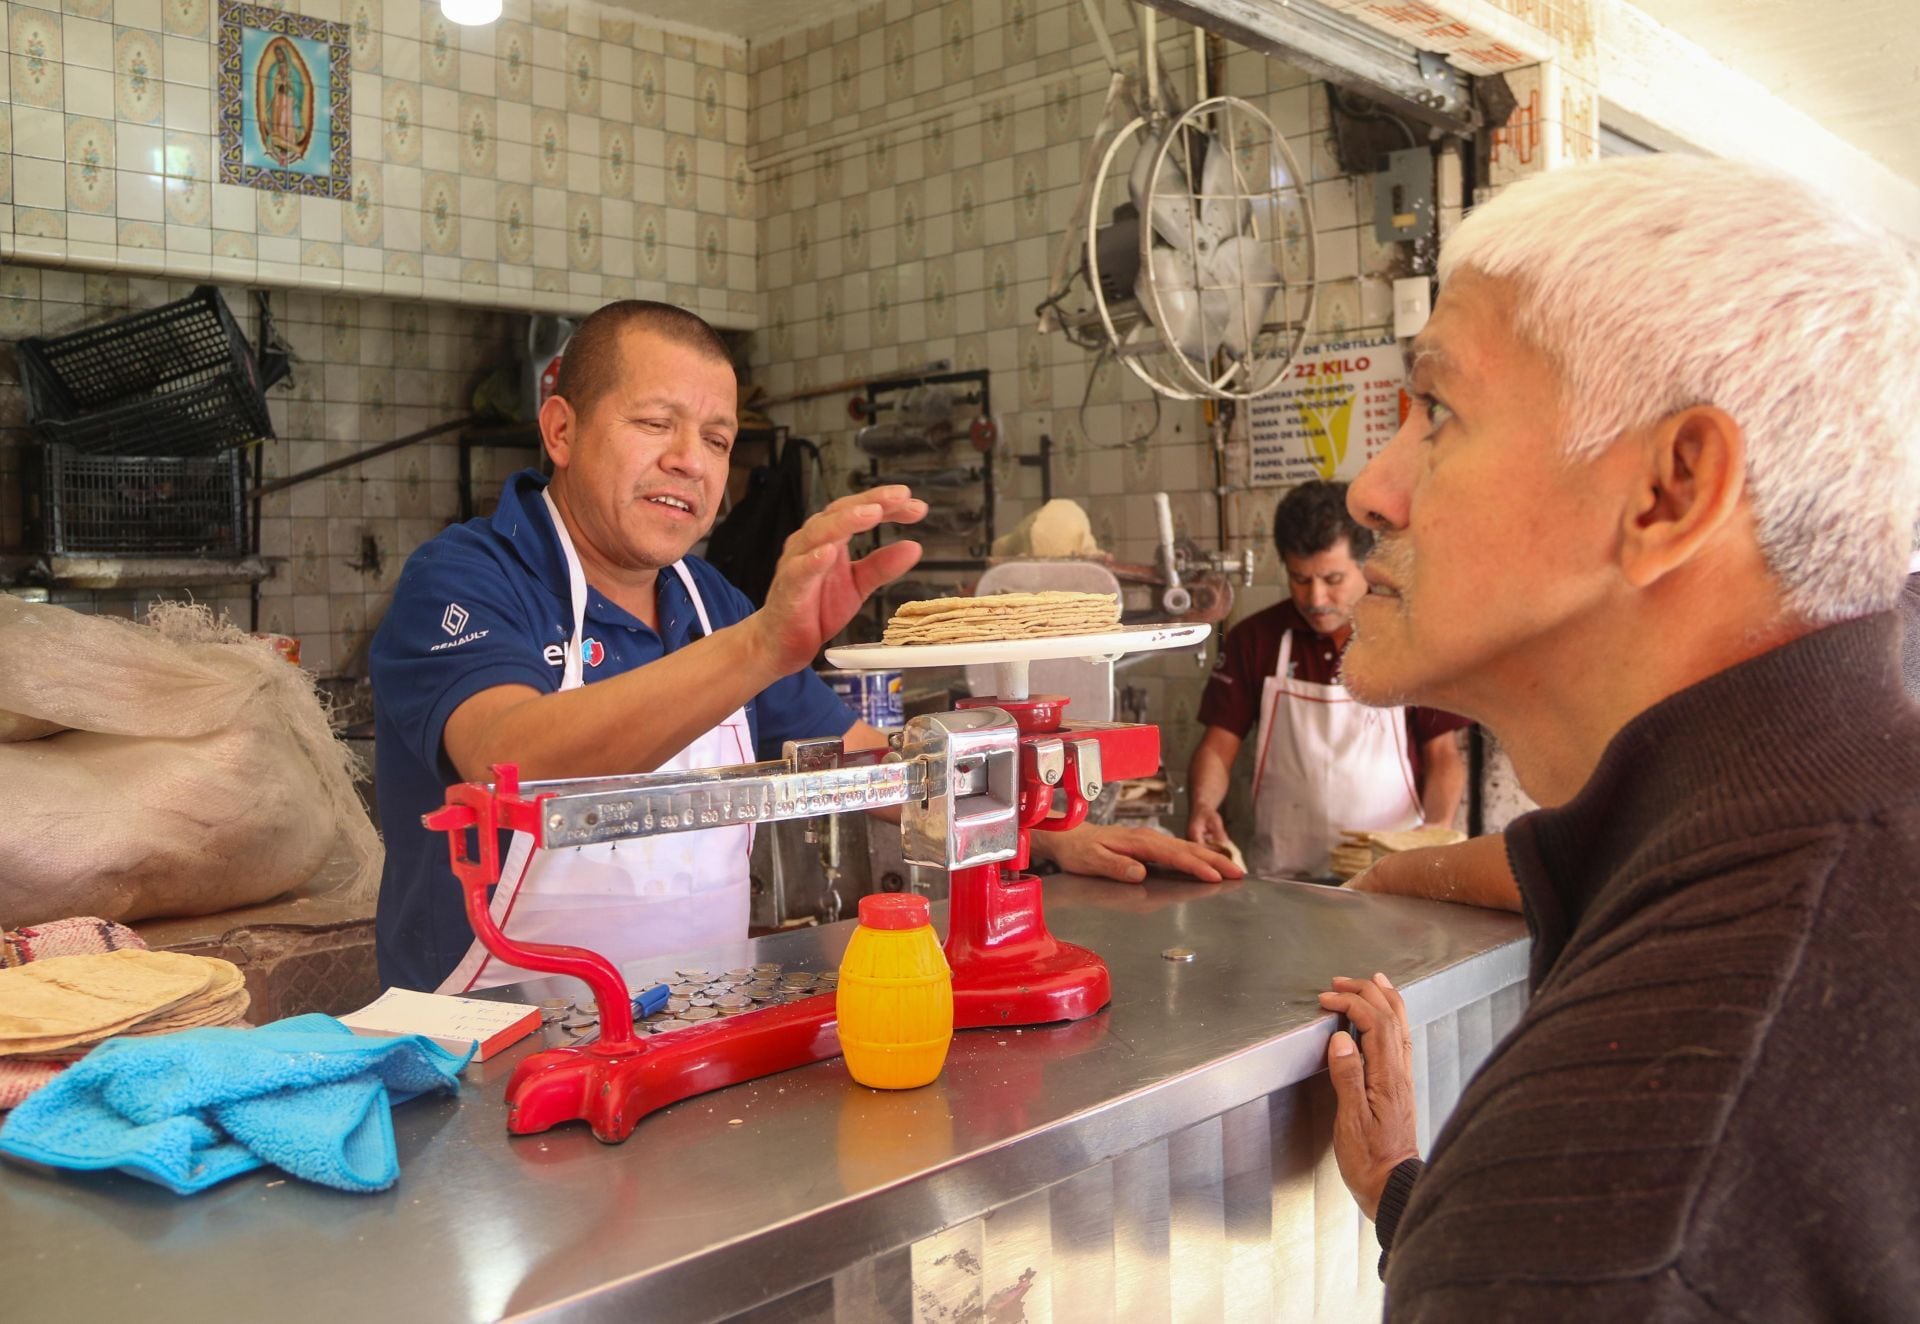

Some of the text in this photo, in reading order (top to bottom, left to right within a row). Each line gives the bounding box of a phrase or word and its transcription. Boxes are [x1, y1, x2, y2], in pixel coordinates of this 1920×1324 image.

[1303, 346, 1321, 355] DE
[1325, 335, 1396, 351] TORTILLAS
[1294, 362, 1317, 378] 22
[1322, 357, 1371, 375] KILO
[1252, 405, 1281, 415] SOPES
[1252, 419, 1280, 428] MASA
[1253, 432, 1278, 441] VASO
[1280, 430, 1293, 439] DE
[1296, 428, 1327, 438] SALSA
[1253, 445, 1285, 455] BOLSA
[1254, 458, 1283, 468] PAPEL
[1254, 472, 1283, 481] PAPEL
[430, 630, 489, 652] RENAULT
